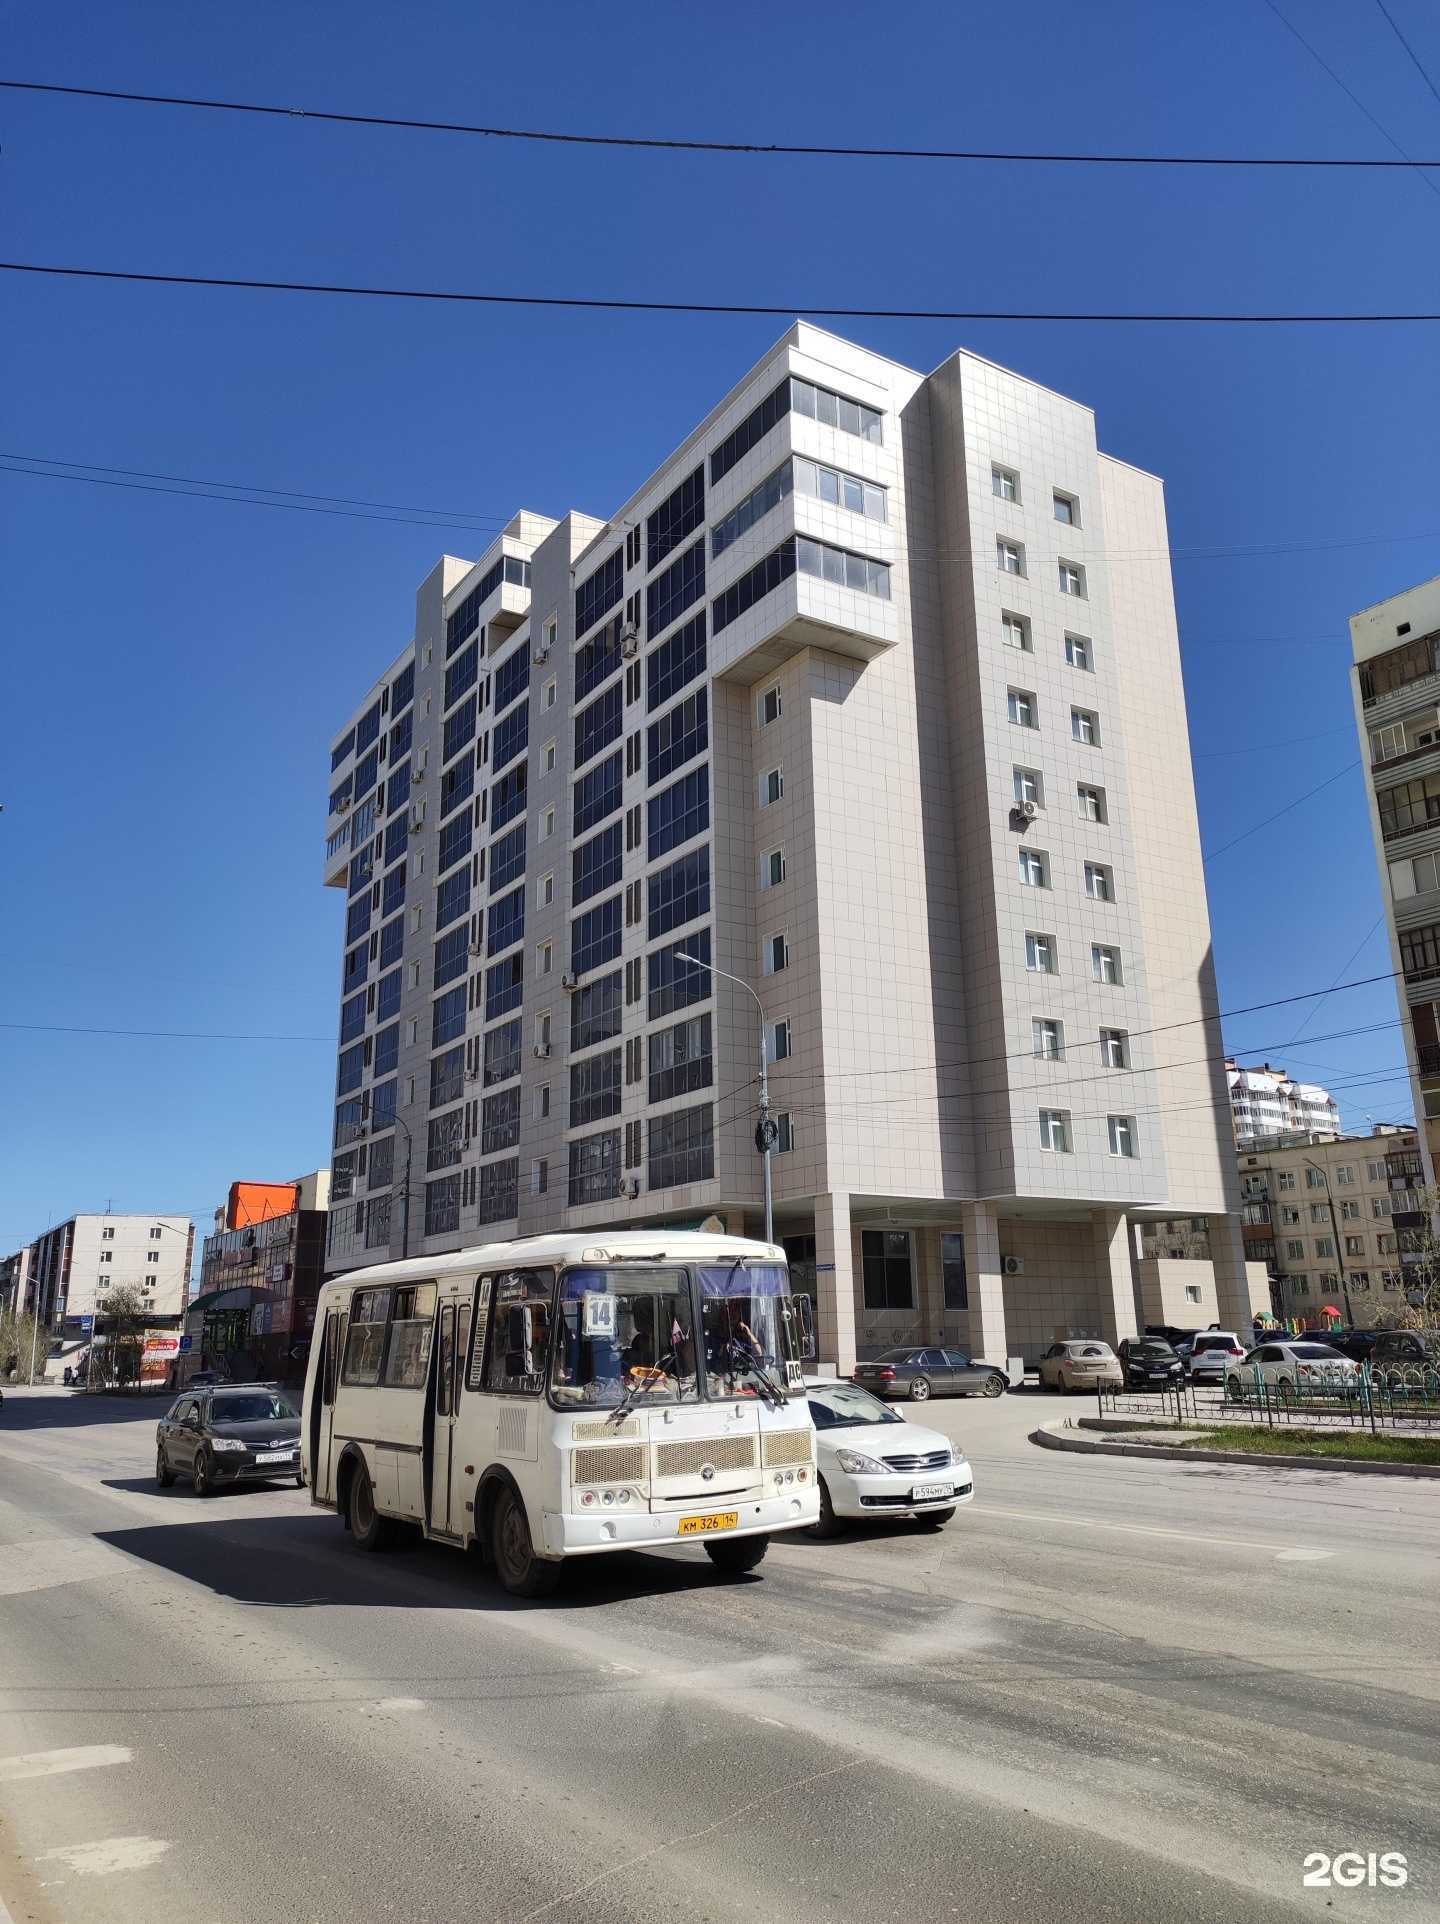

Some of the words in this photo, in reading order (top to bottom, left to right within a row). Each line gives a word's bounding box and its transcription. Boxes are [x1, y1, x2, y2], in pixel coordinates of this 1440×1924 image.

[590, 1302, 610, 1325] 14
[788, 1363, 800, 1382] ДС
[701, 1517, 719, 1530] 326
[725, 1513, 734, 1525] 14
